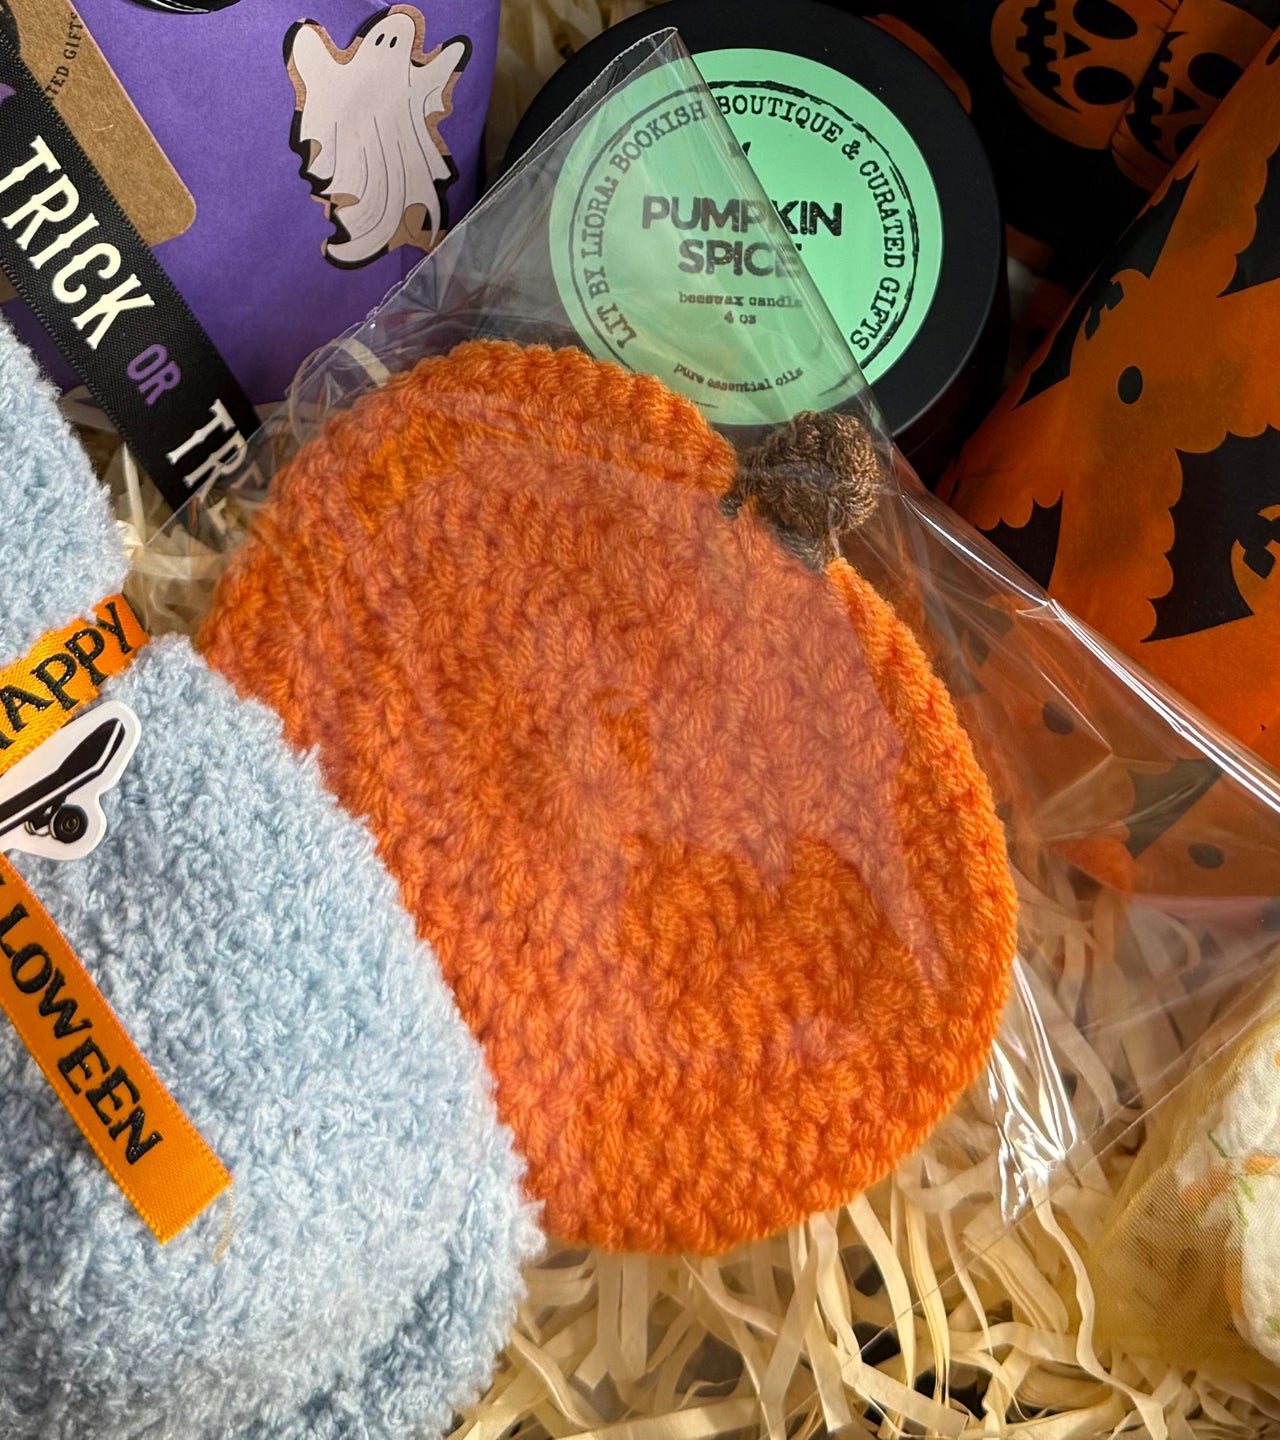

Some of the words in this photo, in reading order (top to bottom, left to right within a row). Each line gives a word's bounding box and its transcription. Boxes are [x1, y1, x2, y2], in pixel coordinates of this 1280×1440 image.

[609, 99, 708, 174] BOOKISH
[716, 94, 844, 143] BOUTIQUE
[841, 139, 862, 160] &
[641, 194, 843, 237] PUMPKIN
[859, 160, 905, 269] CURATED
[584, 265, 610, 299] BY
[597, 301, 637, 350] LIT
[850, 276, 900, 350] GIFTS
[126, 343, 182, 406] OR
[673, 362, 705, 385] pure
[707, 377, 774, 393] essential
[775, 367, 804, 386] oils
